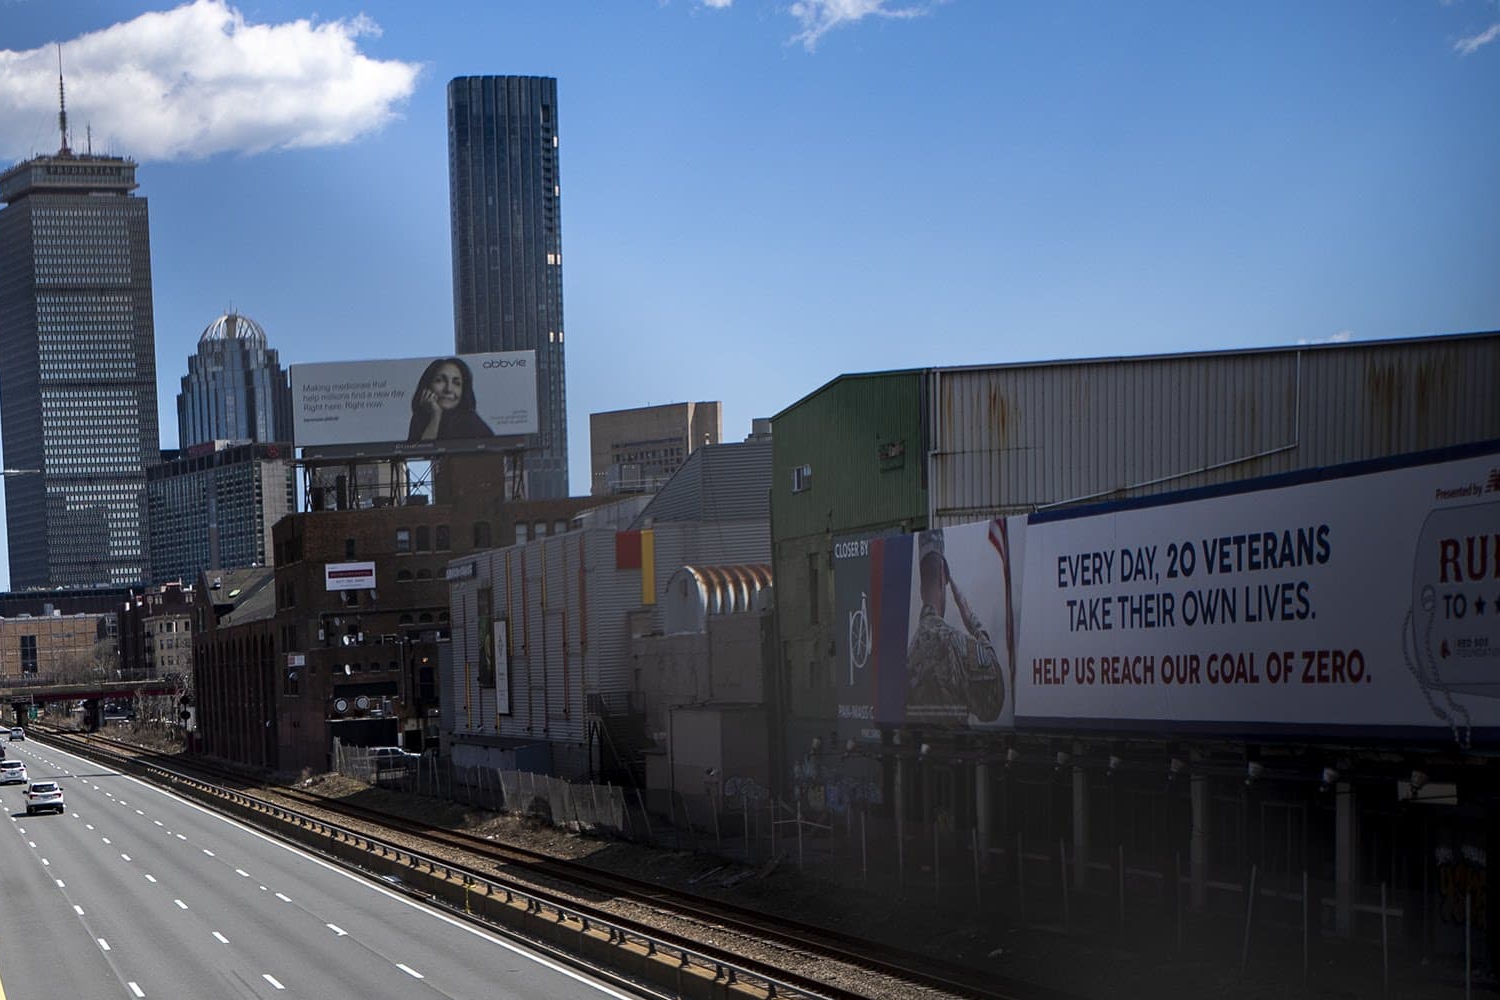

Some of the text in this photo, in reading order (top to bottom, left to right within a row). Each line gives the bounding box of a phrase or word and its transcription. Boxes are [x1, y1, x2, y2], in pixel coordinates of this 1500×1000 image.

[482, 358, 526, 369] abbvie
[1473, 482, 1483, 498] by
[835, 540, 869, 559] CLOSER BY
[1058, 524, 1331, 588] EVERY DAY, 20 VETERANS
[1067, 581, 1316, 632] TAKE THEIR OWN LIVES.
[1443, 593, 1467, 620] TO
[1032, 648, 1372, 685] HELP US REACH OUR GOAL OF ZERO.
